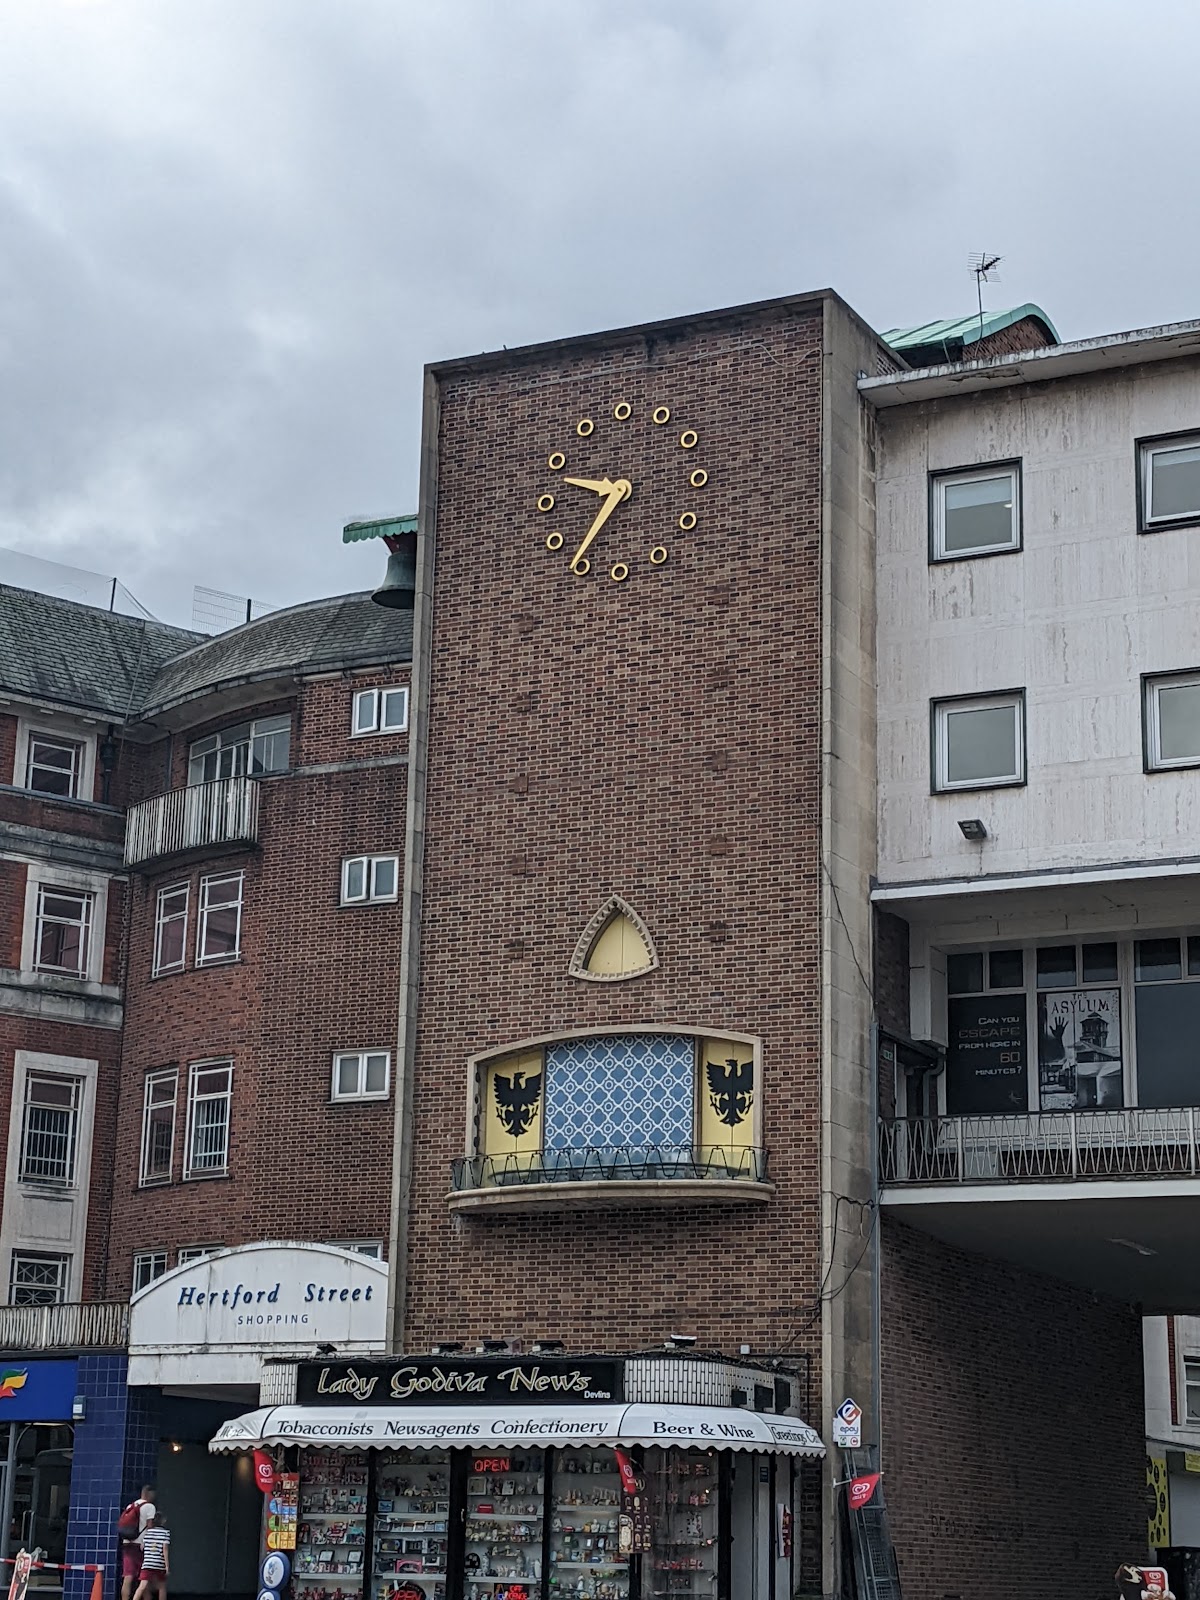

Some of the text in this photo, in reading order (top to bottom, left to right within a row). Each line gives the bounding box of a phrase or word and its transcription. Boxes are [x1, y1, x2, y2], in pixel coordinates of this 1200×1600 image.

[1051, 999, 1110, 1014] ASYLUM
[958, 1027, 1020, 1039] ESCAPE
[958, 1042, 984, 1050] FROM
[1000, 1051, 1020, 1064] 60
[975, 1066, 1022, 1076] MINUTES?
[178, 1283, 373, 1309] Hertford Street
[237, 1314, 310, 1325] SHOPPING
[317, 1366, 593, 1400] Lady Godiva News
[584, 1390, 611, 1399] Devlins
[277, 1419, 608, 1437] Tobacconists Newsagents Confectionery
[653, 1421, 756, 1439] Beer & Wine
[840, 1426, 859, 1435] epay
[771, 1426, 808, 1446] Greetings
[474, 1458, 511, 1472] OPEN
